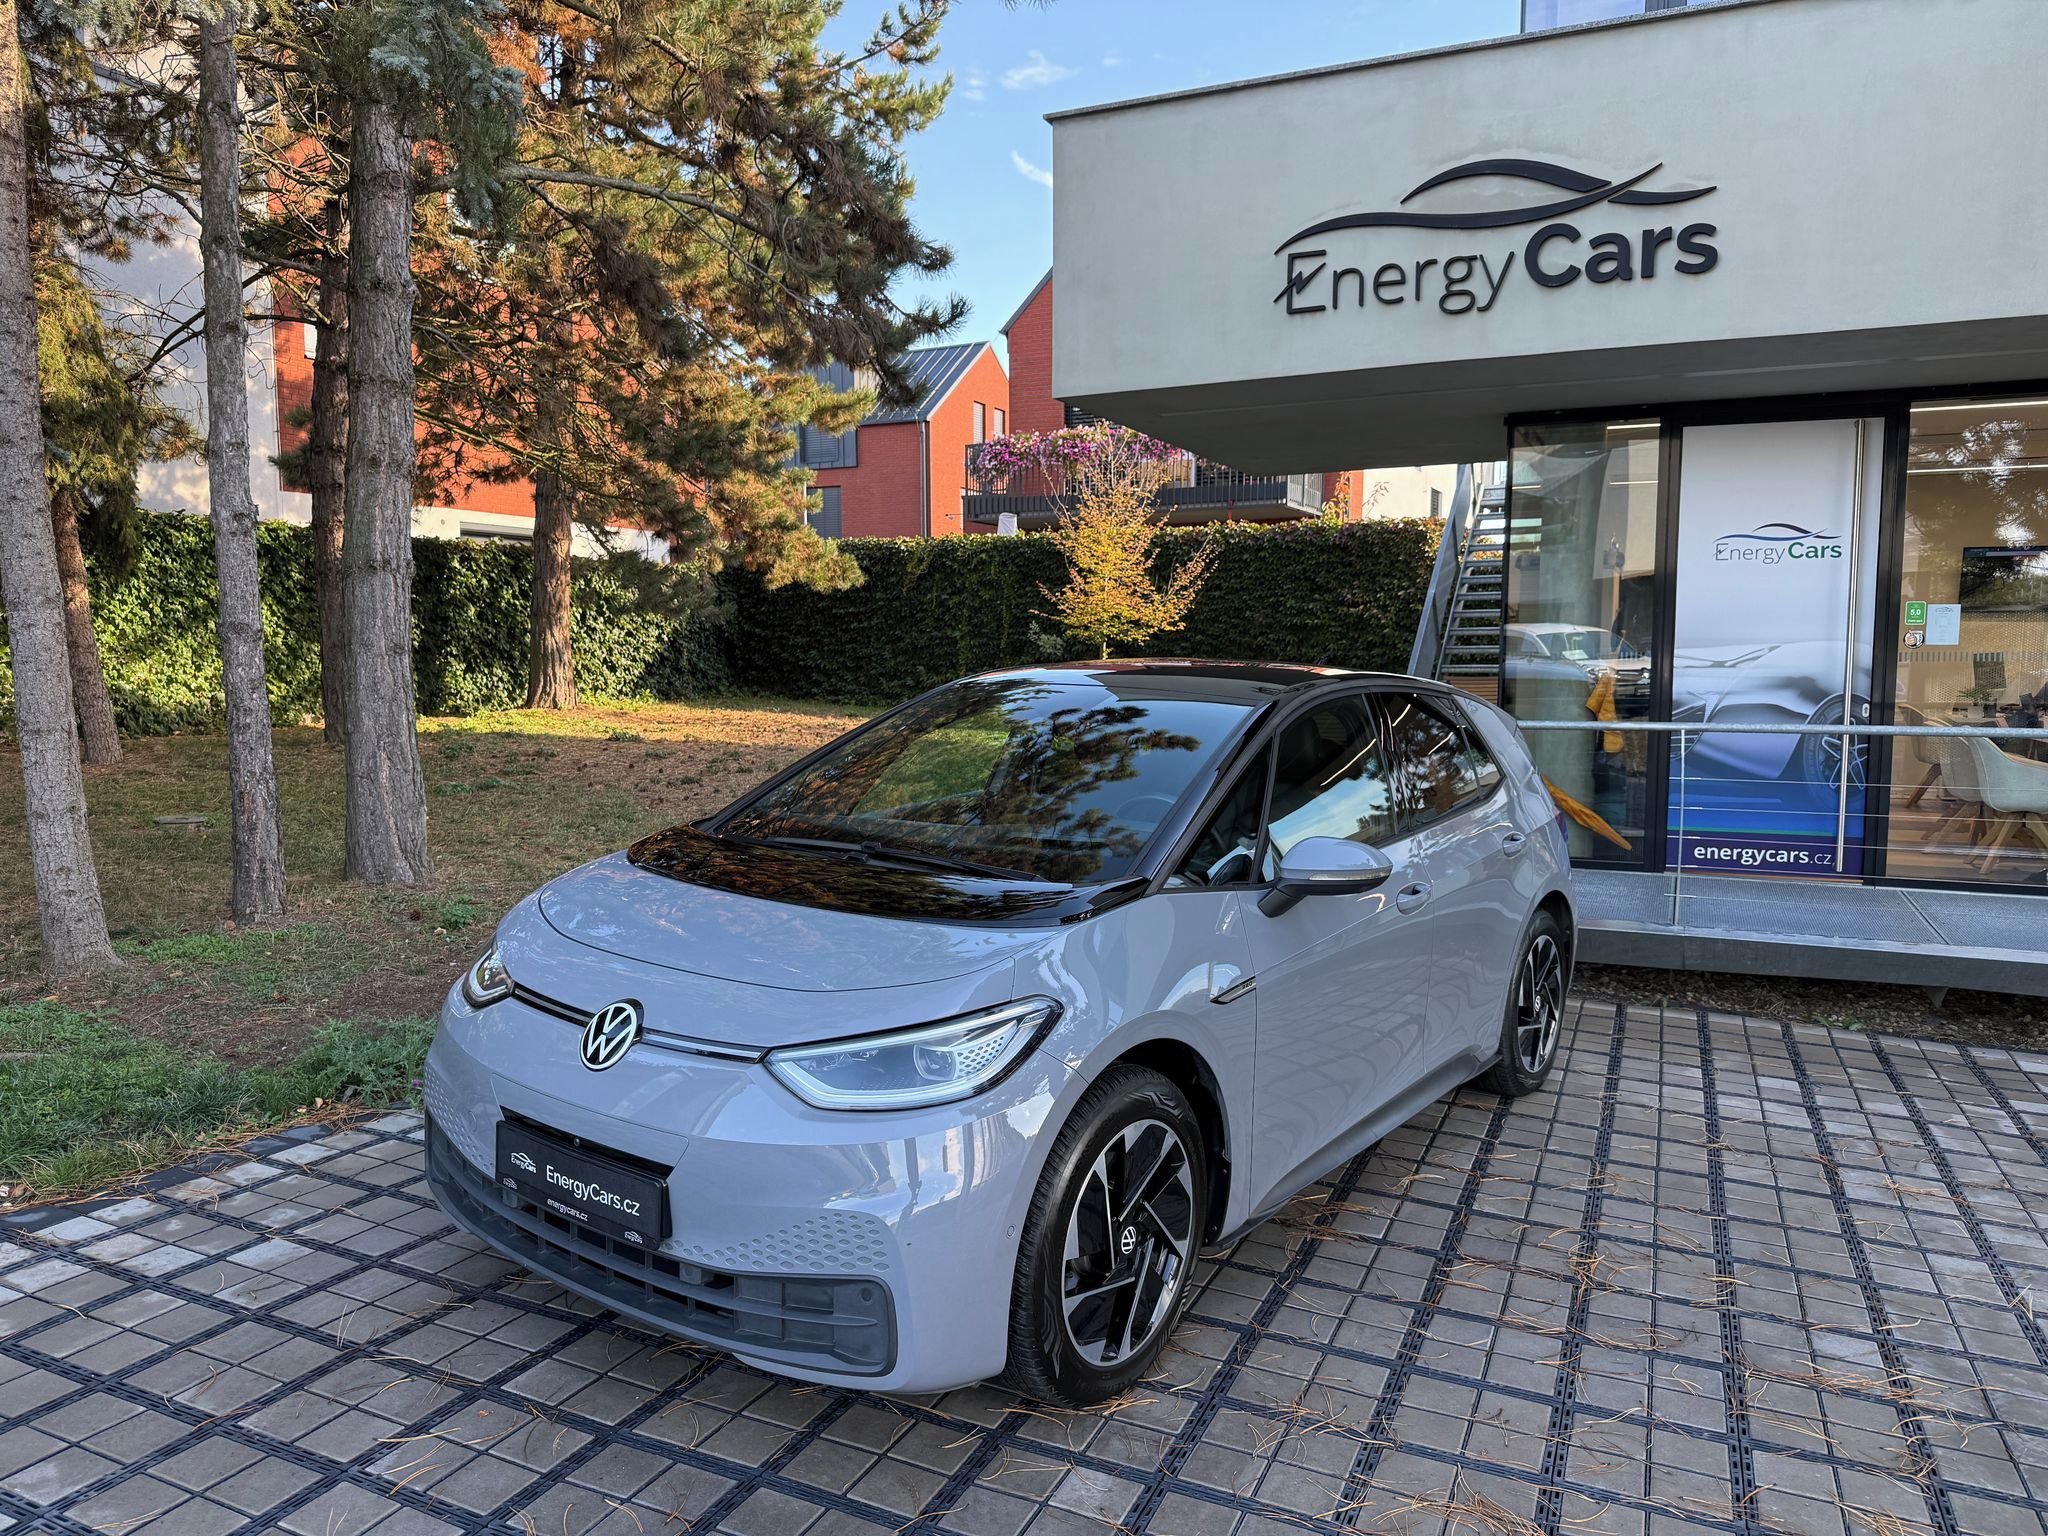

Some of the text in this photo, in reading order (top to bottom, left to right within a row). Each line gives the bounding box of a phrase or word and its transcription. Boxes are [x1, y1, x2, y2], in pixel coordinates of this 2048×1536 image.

[1694, 846, 1832, 866] energycars.cz
[546, 1164, 640, 1217] EnergyCars.cz
[547, 1198, 589, 1221] energycars.cz
